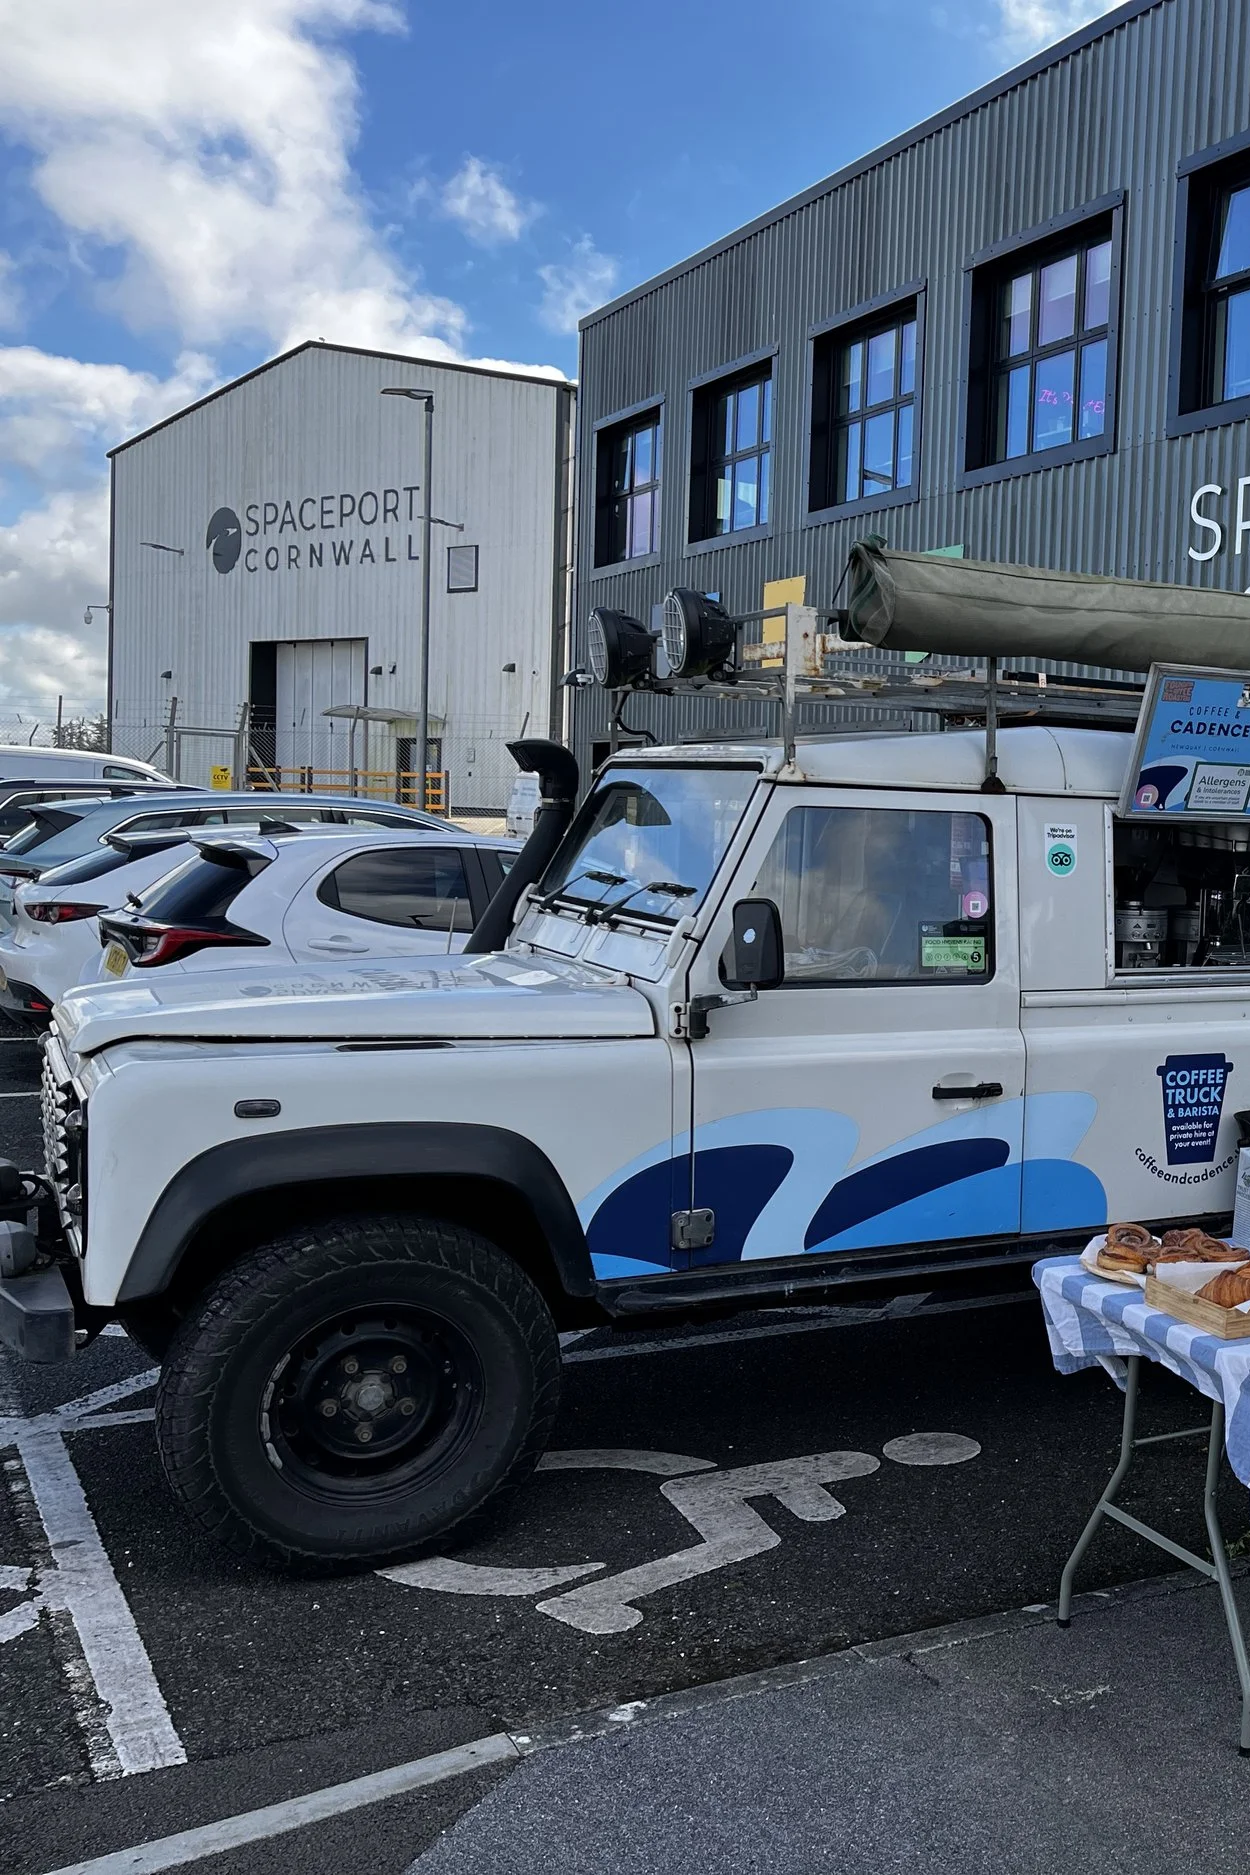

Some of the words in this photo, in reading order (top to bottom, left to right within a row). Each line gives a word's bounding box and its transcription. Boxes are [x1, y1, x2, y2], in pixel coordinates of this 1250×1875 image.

[245, 486, 420, 537] SPACEPORT
[245, 534, 420, 573] CORNWALL
[1189, 706, 1230, 717] COFFEE
[1234, 711, 1241, 719] &
[1199, 776, 1247, 788] Allergens
[1203, 787, 1241, 795] Intolerances
[973, 952, 979, 962] 5
[1165, 1068, 1225, 1087] COFFEE
[1165, 1086, 1222, 1105] TRUCK
[1167, 1108, 1175, 1118] &
[1177, 1105, 1220, 1118] BARISTA
[1171, 1122, 1202, 1131] available
[1203, 1121, 1214, 1129] for
[1169, 1132, 1193, 1142] private
[1193, 1130, 1207, 1138] hire
[1174, 1141, 1190, 1150] your
[1190, 1138, 1211, 1147] event!
